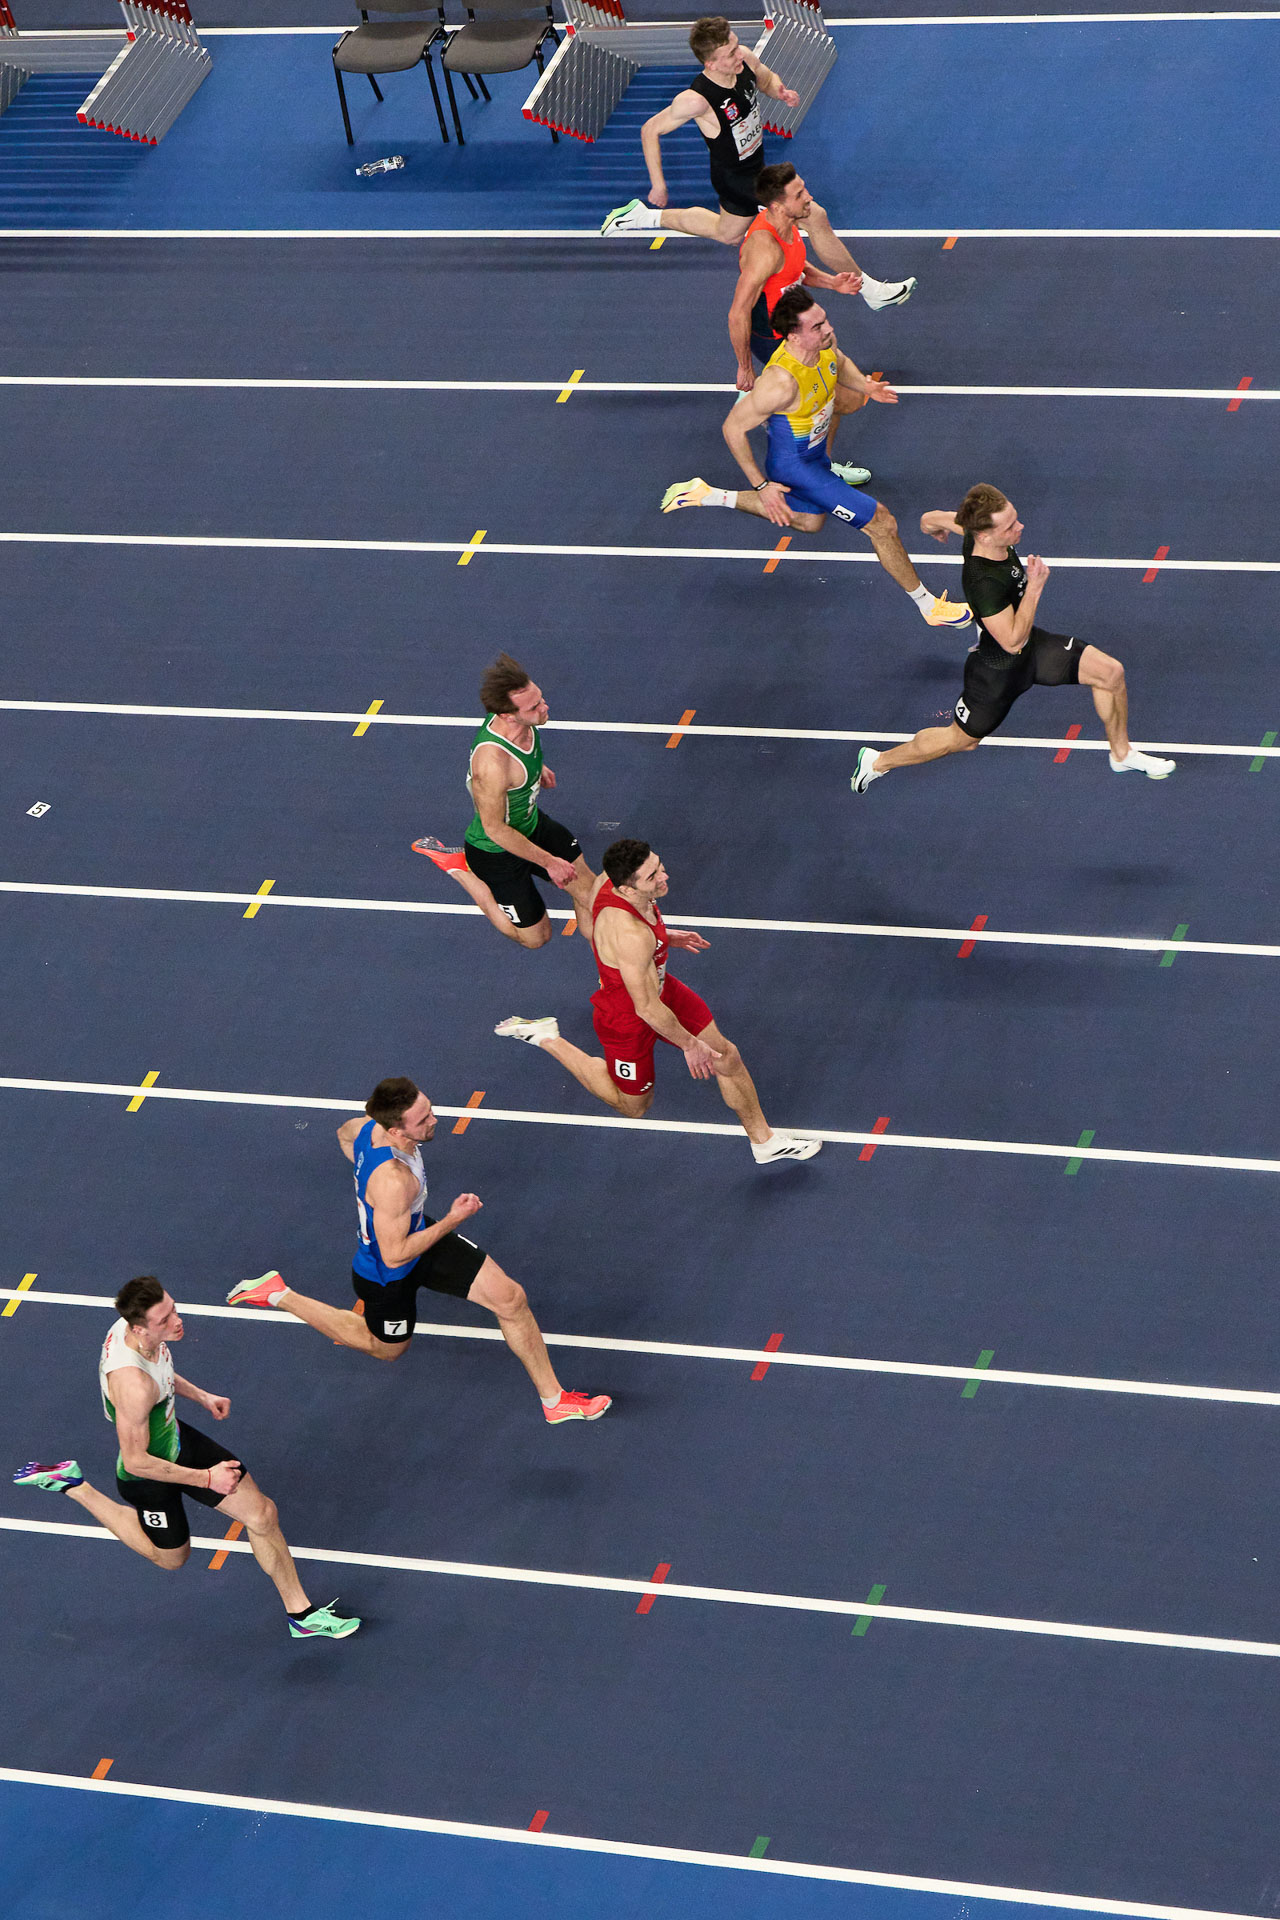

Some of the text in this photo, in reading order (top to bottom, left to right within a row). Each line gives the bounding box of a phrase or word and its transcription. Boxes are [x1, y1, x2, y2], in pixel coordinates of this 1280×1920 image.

[835, 510, 851, 520] 3
[957, 706, 966, 718] 4
[31, 804, 46, 815] 5
[619, 1063, 631, 1077] 6
[388, 1322, 402, 1335] 7
[149, 1513, 161, 1526] 8
